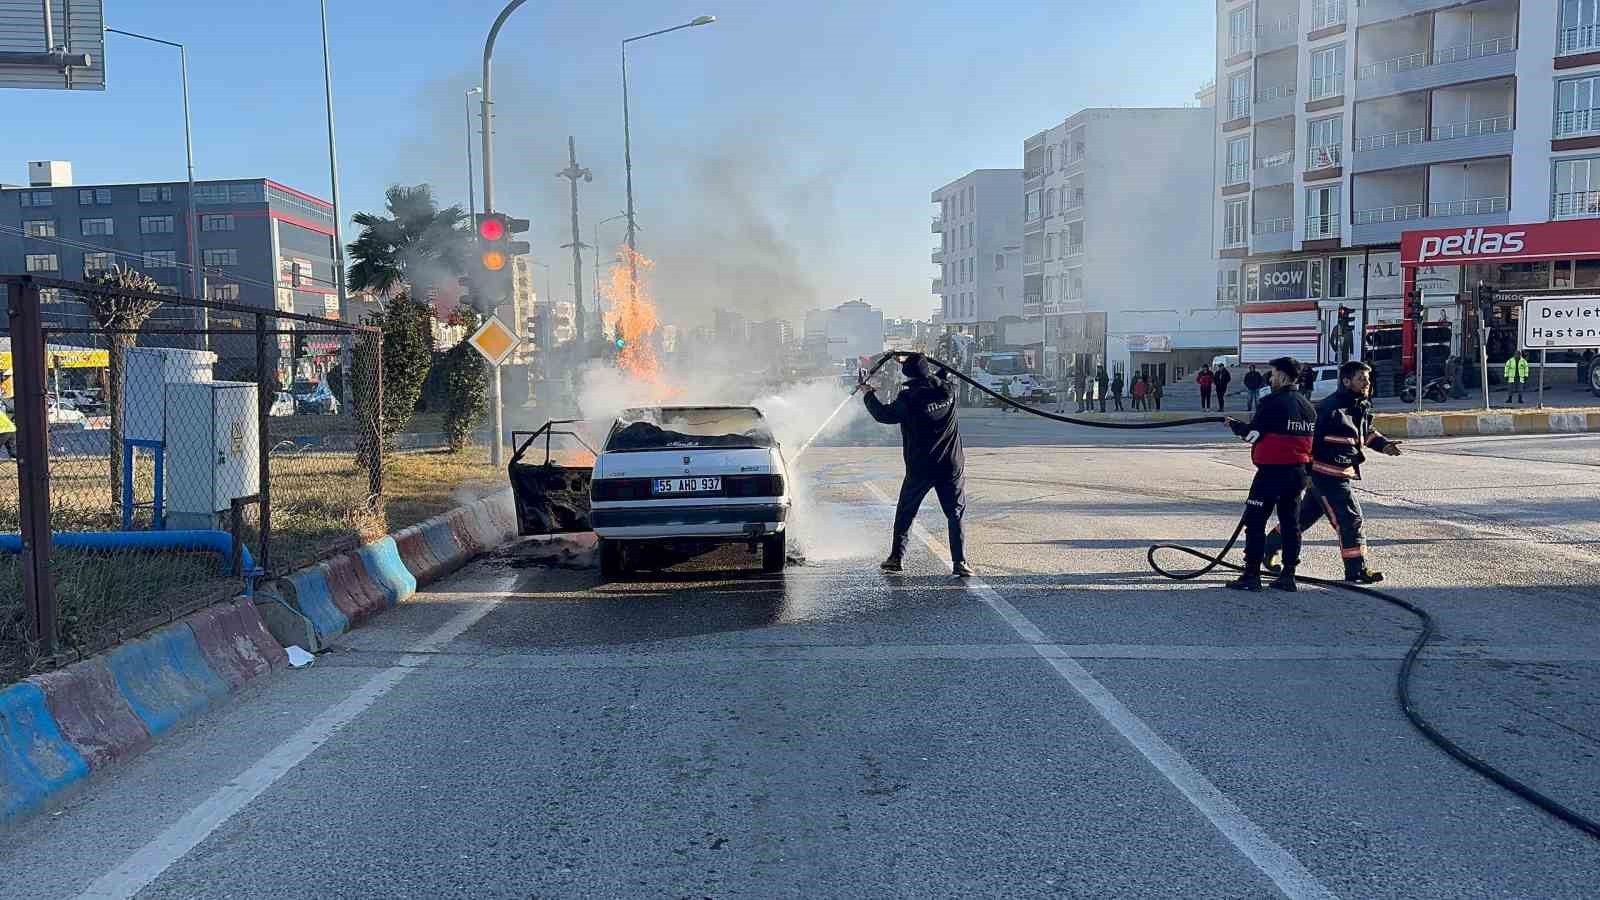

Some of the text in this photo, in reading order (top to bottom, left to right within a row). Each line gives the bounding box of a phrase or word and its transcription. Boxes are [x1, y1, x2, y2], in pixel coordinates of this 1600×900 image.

[1419, 228, 1525, 263] petlas
[1542, 307, 1600, 318] Devlet
[1532, 327, 1600, 338] Hastan
[660, 480, 672, 491] 55
[701, 478, 720, 490] 937
